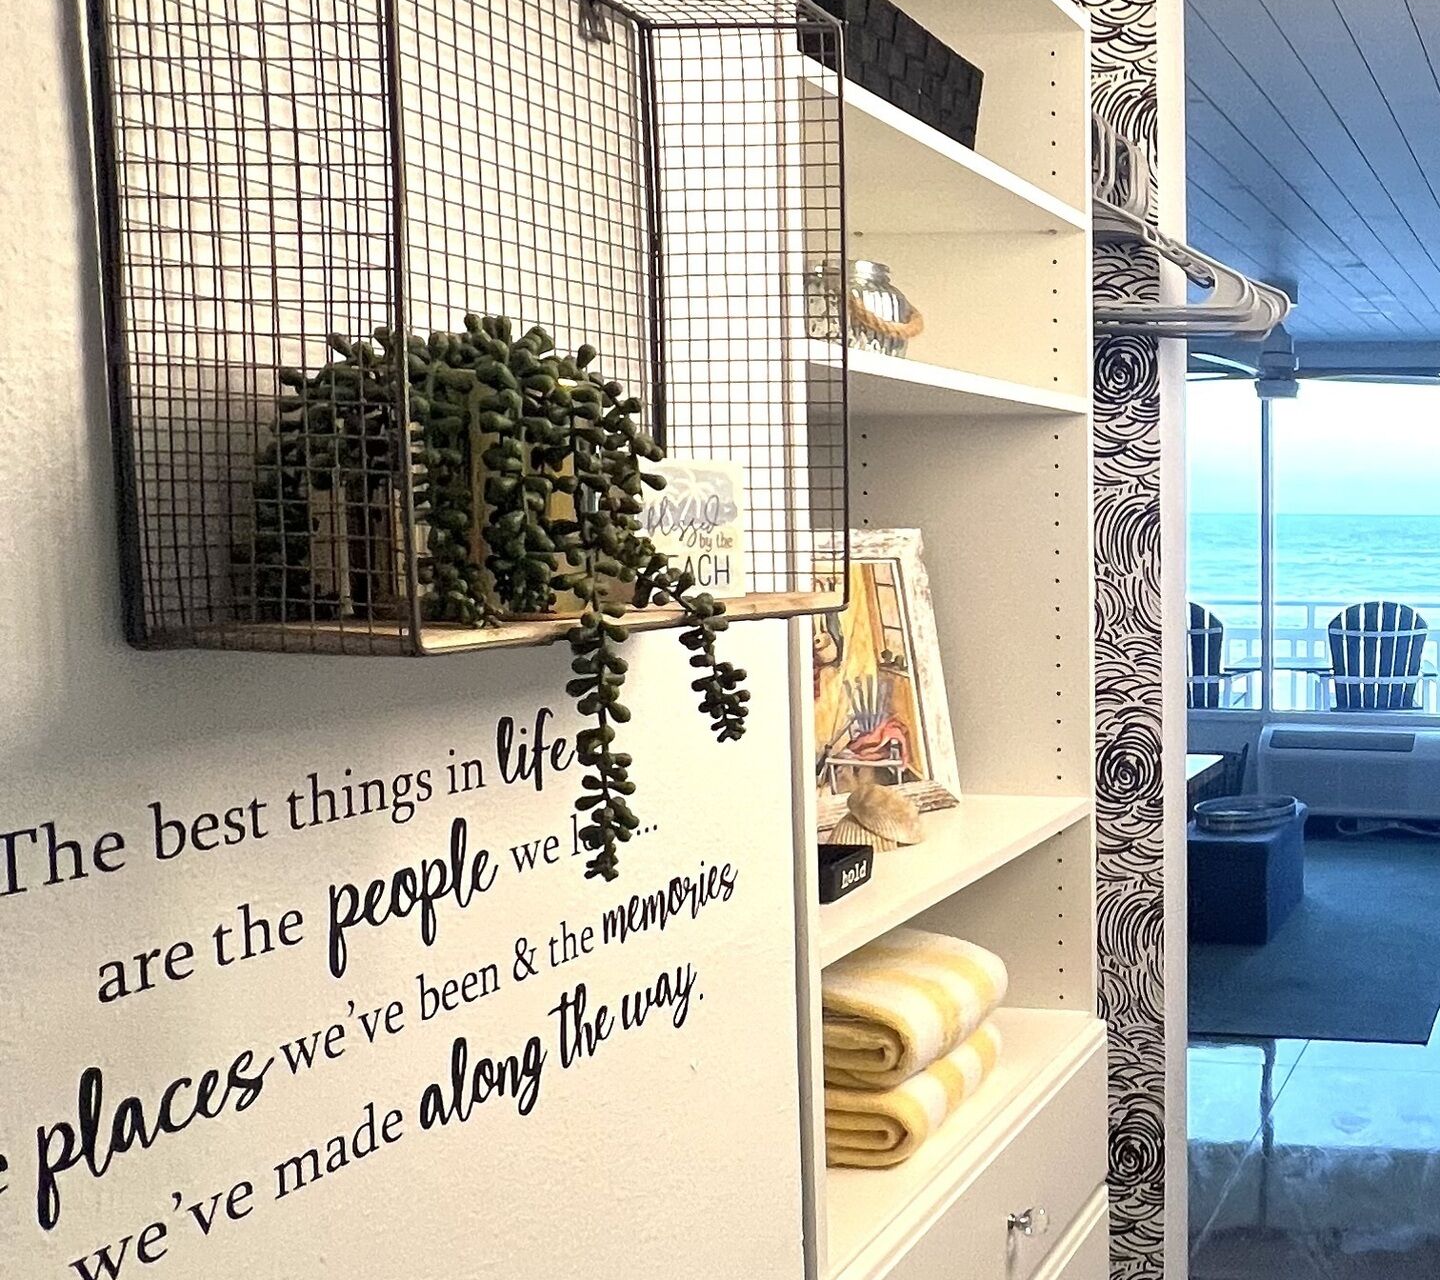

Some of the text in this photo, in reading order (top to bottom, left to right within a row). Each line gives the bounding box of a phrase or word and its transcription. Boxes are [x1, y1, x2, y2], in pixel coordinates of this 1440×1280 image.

[716, 531, 734, 550] the
[0, 707, 577, 897] The best things in life
[97, 940, 195, 1004] are
[211, 902, 304, 967] the
[328, 816, 499, 979] people
[508, 834, 561, 874] we
[36, 1048, 275, 1231] places
[279, 999, 406, 1076] we've
[415, 963, 501, 1022] been
[512, 936, 540, 983] &
[548, 919, 595, 968] the
[602, 860, 740, 945] memories
[272, 1100, 405, 1201] made
[418, 1035, 549, 1131] along
[546, 981, 617, 1070] the
[620, 961, 706, 1032] way.
